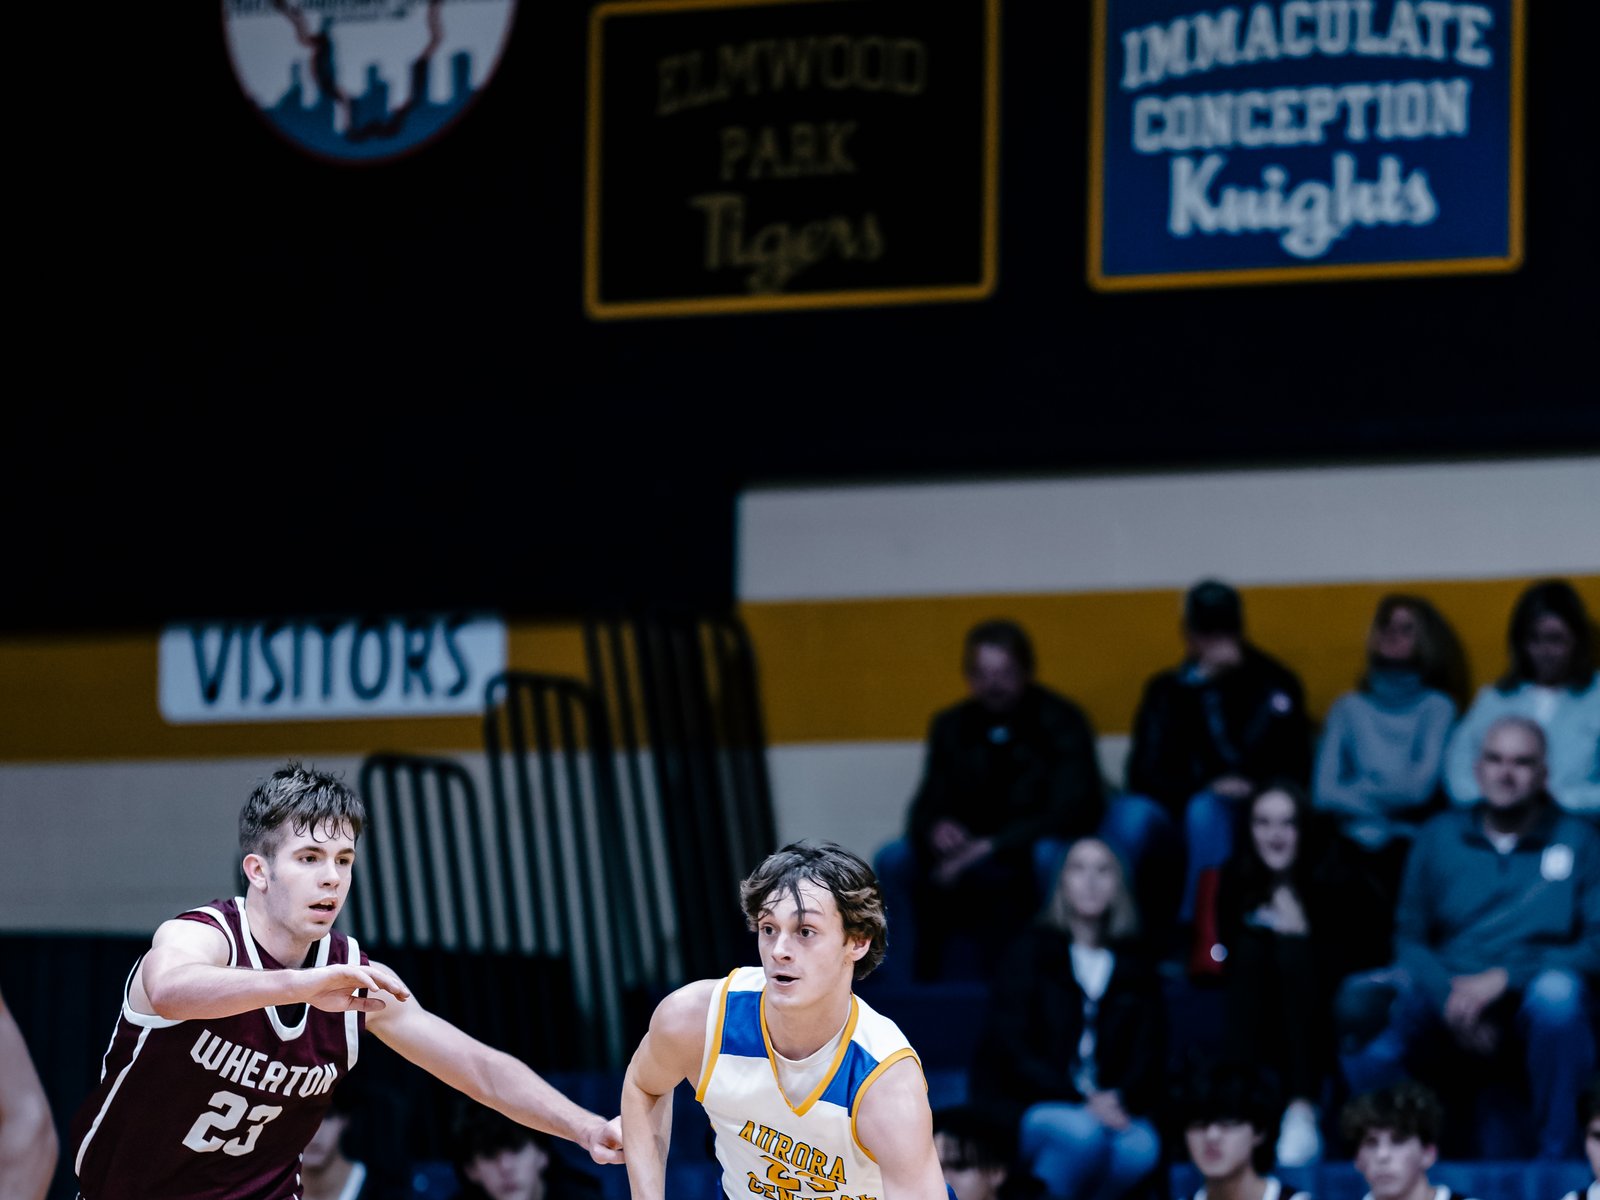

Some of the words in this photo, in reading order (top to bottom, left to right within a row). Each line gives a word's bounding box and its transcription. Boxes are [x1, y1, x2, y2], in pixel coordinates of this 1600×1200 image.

[656, 34, 929, 117] ELMWOOD
[1119, 0, 1494, 90] IMMACULATE
[718, 121, 858, 181] PARK
[1131, 78, 1471, 153] CONCEPTION
[688, 192, 886, 296] Tigers
[1167, 151, 1439, 258] Knights
[187, 614, 474, 706] VISITORS
[190, 1028, 338, 1098] WHEATON
[182, 1090, 283, 1157] 23
[738, 1119, 847, 1185] AURORA
